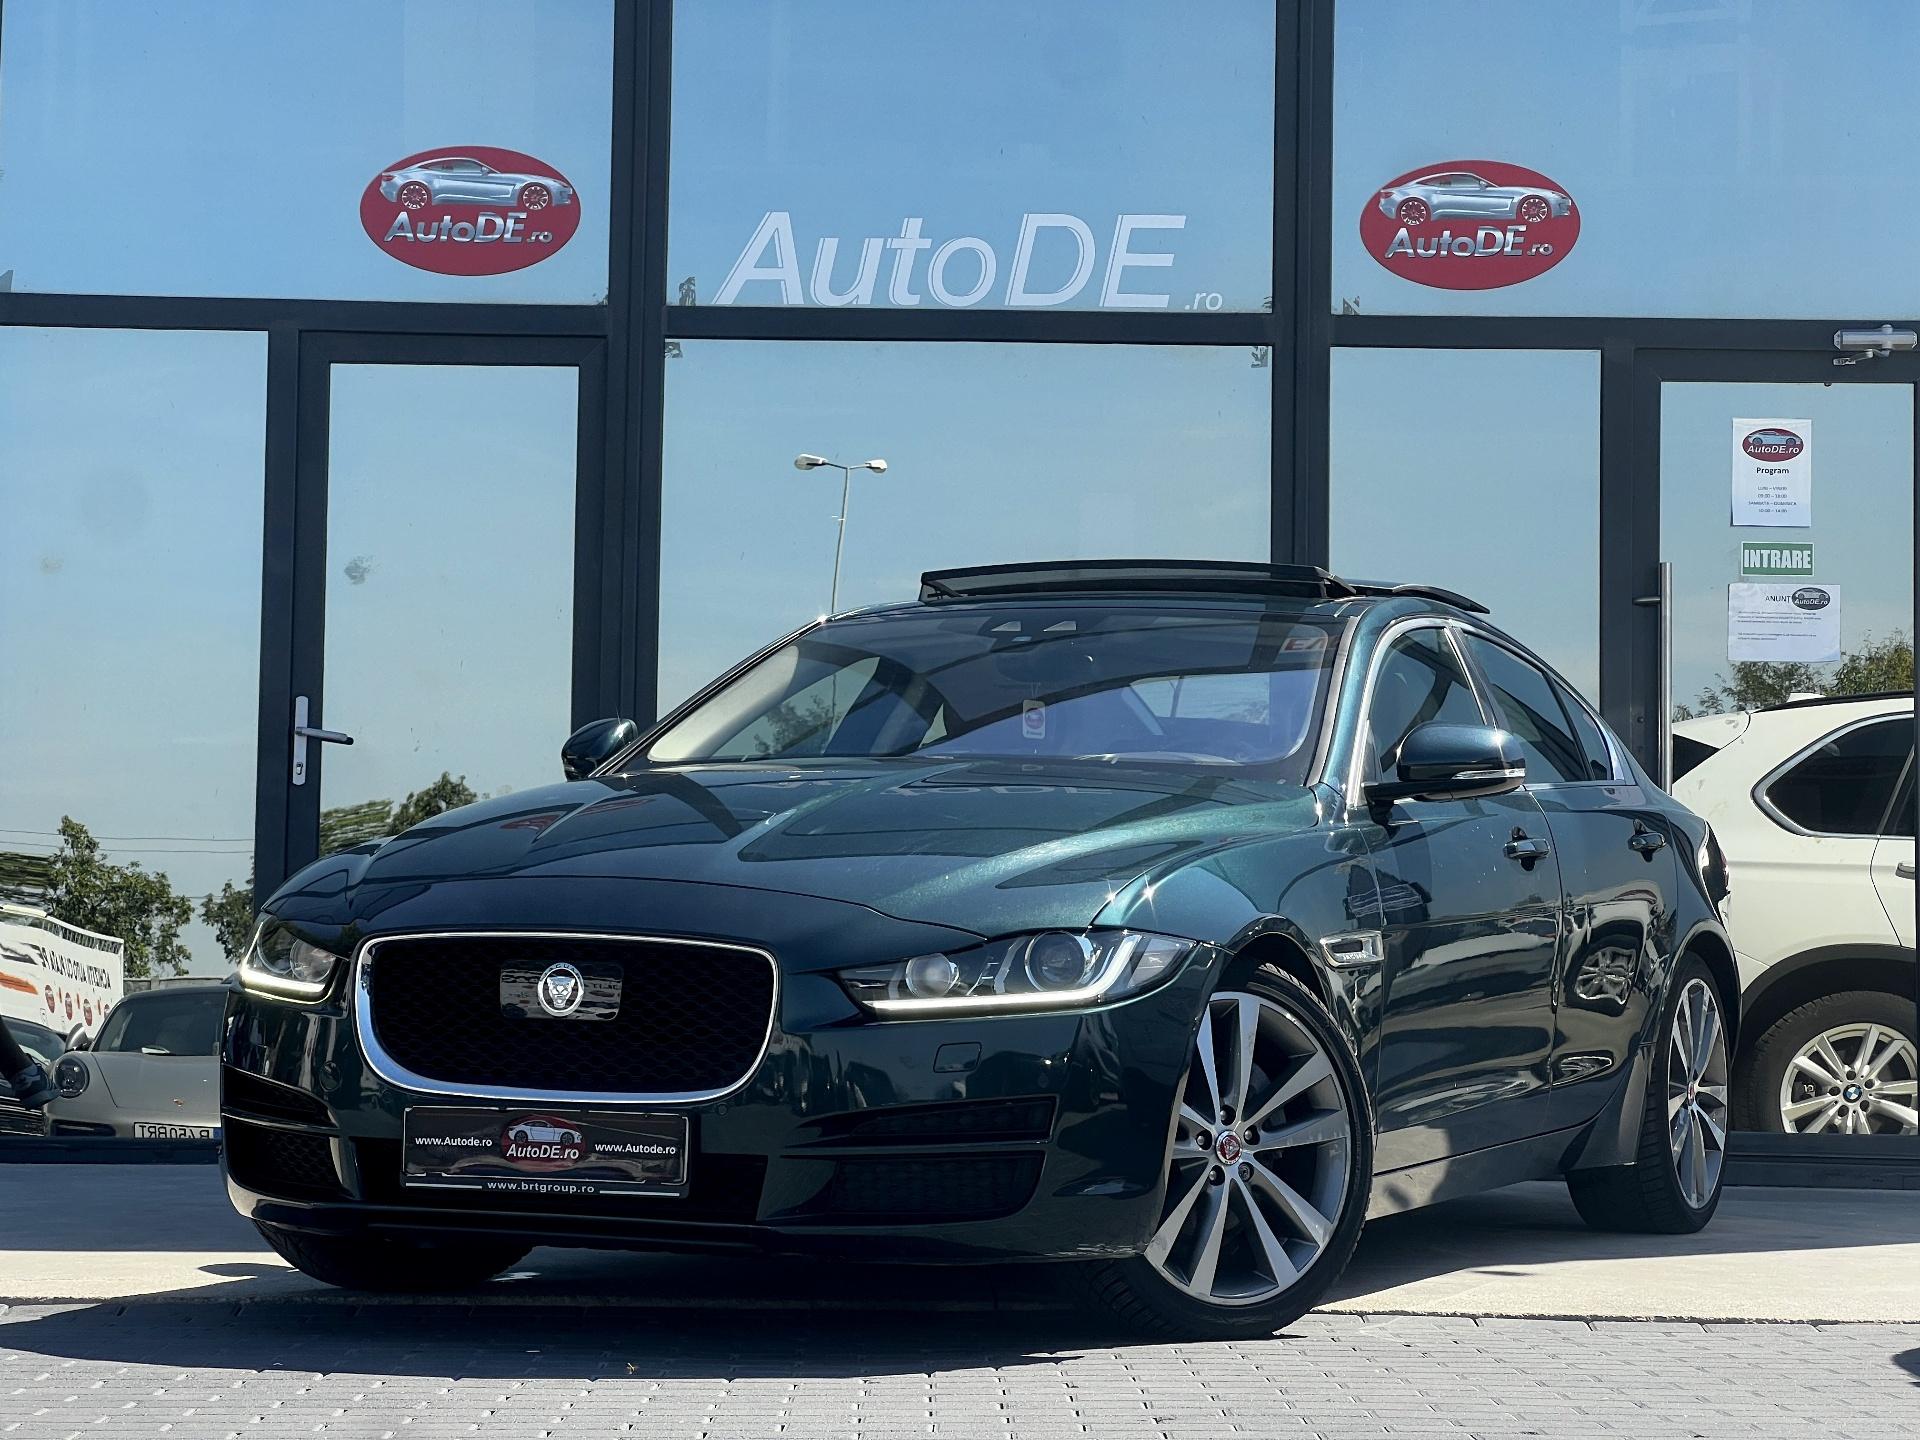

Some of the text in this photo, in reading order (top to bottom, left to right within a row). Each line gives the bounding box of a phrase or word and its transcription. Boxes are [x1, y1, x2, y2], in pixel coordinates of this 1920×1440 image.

[1747, 445, 1800, 454] AutoDE.ro
[1756, 466, 1790, 475] Program
[1743, 549, 1812, 569] INTRARE
[414, 1135, 493, 1147] www.Autode.ro
[506, 1143, 579, 1160] AutoDE.ro
[594, 1143, 676, 1155] www.Autode.ro
[486, 1180, 595, 1194] www.brtgroup.ro
